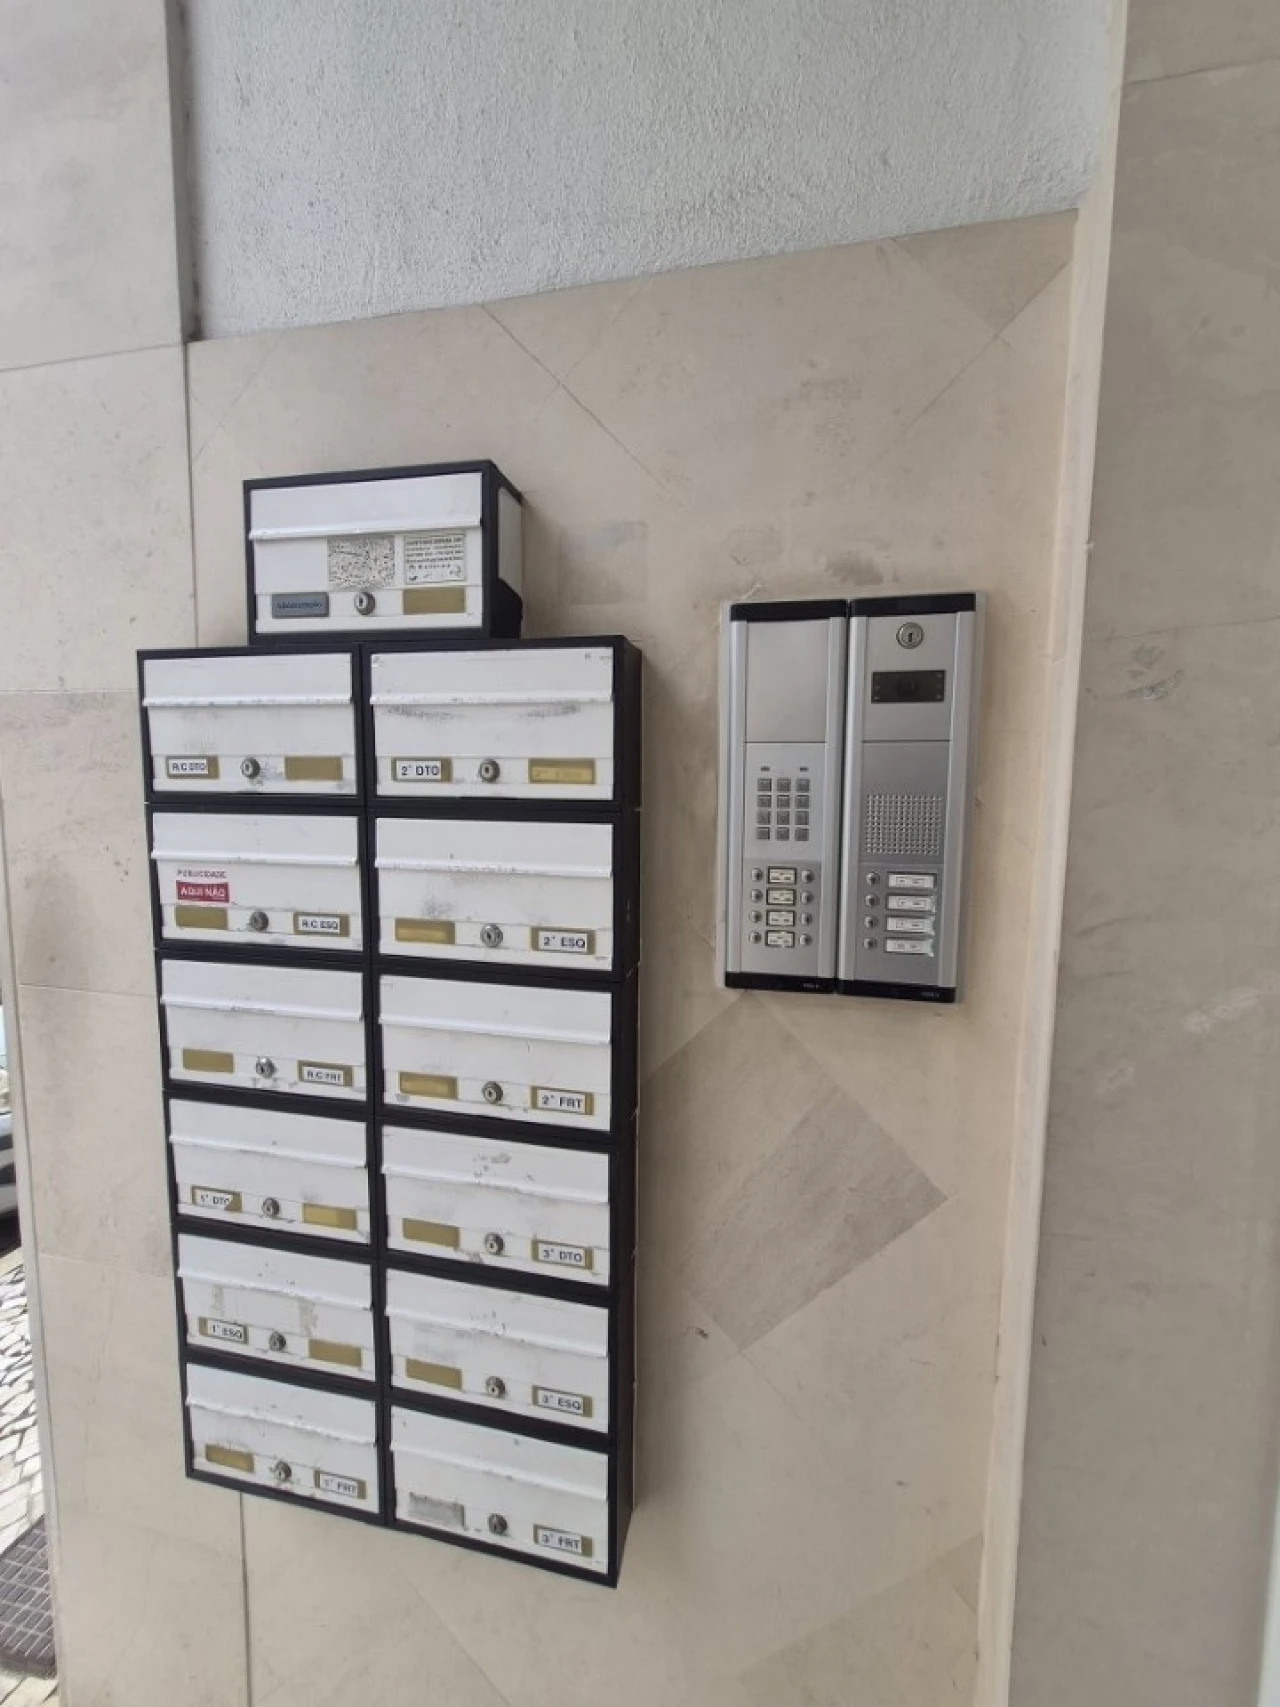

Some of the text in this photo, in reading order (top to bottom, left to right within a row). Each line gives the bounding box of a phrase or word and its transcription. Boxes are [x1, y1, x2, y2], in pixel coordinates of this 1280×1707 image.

[416, 765, 440, 776] DTO
[178, 868, 227, 879] PUBLICIDADE
[181, 884, 225, 898] AQUI NÃO
[320, 920, 339, 931] ESQ
[560, 937, 585, 949] ESQ
[560, 1096, 583, 1109] FRT
[559, 1251, 582, 1263] DTO
[222, 1327, 243, 1339] ESQ
[557, 1398, 581, 1411] ESQ
[558, 1536, 580, 1550] FRT
